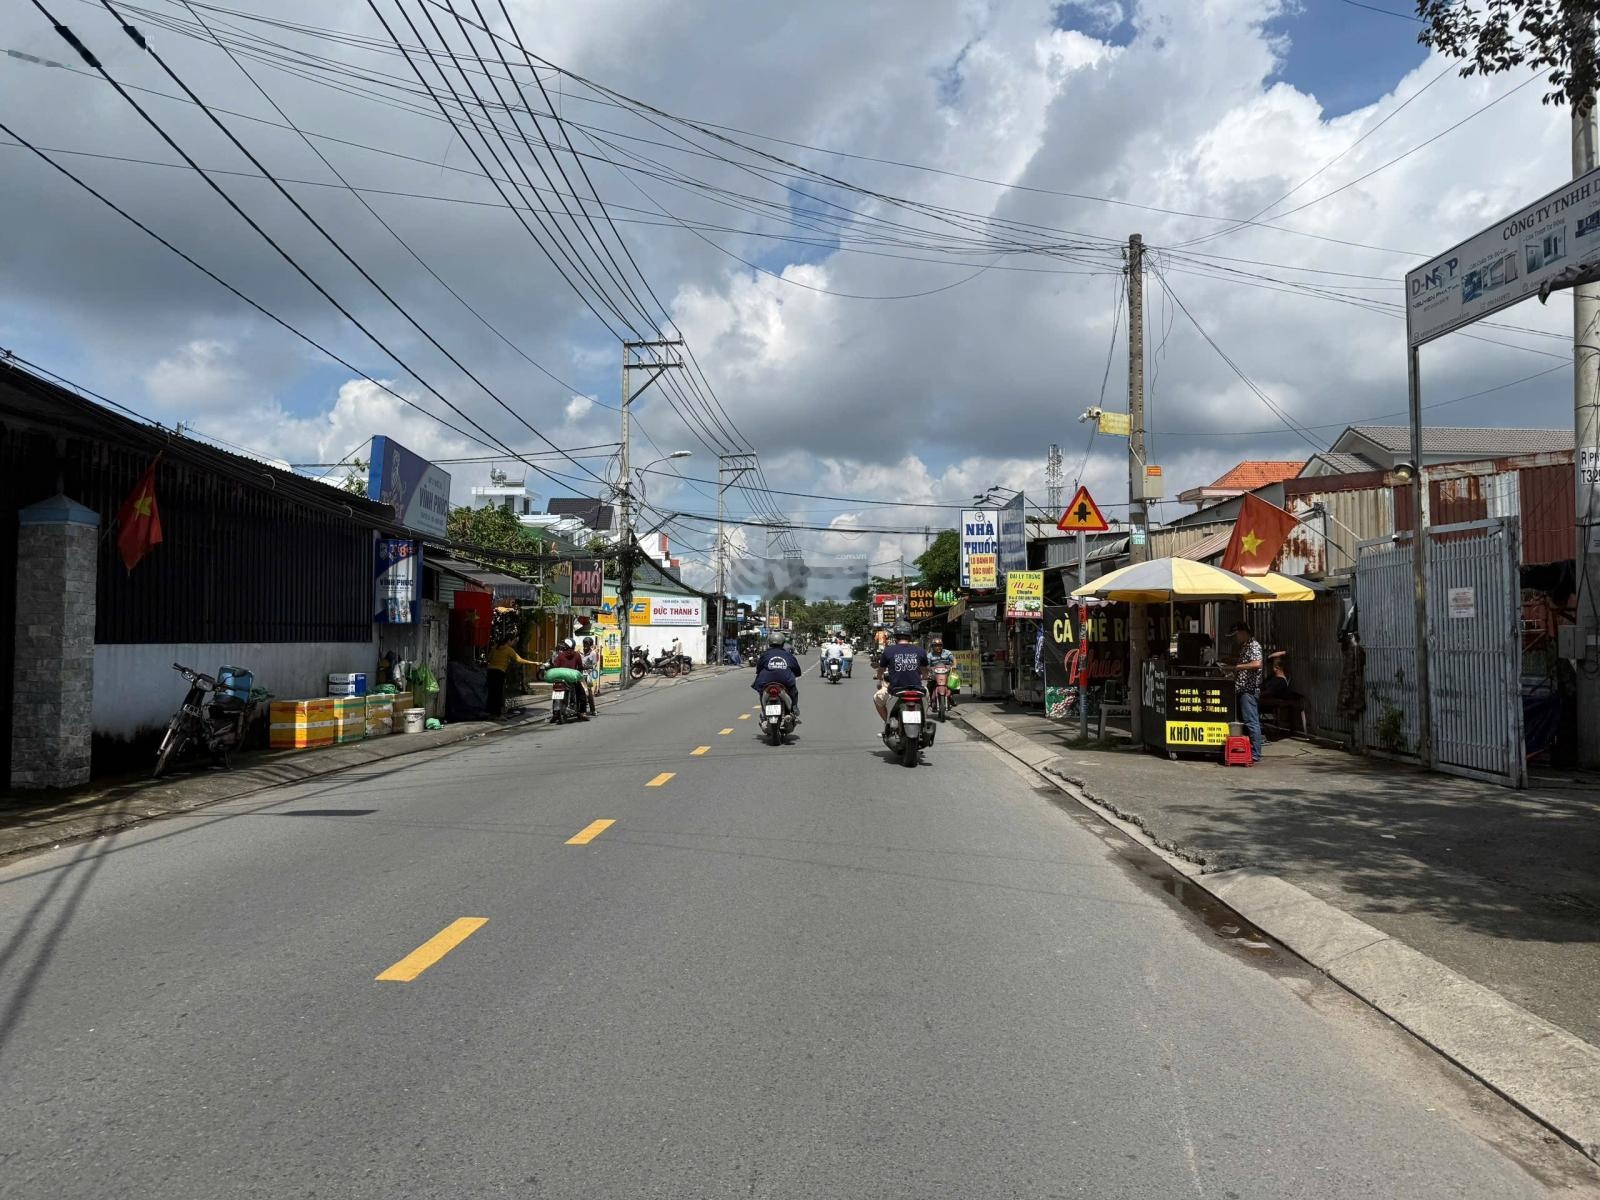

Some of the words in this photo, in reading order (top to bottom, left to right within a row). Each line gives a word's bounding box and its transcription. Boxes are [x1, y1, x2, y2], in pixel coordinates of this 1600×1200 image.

[1503, 213, 1534, 240] CÔNG
[1536, 204, 1551, 223] TY
[1553, 183, 1591, 214] TNHH
[1581, 470, 1600, 483] T32
[966, 521, 994, 535] NHÀ
[964, 537, 997, 554] THUỐC
[573, 562, 601, 593] PHỞ
[910, 588, 933, 598] BÚN
[653, 606, 668, 615] ĐỨC
[670, 606, 693, 616] THÀNH
[694, 608, 699, 616] 5
[910, 599, 933, 610] ĐẬU
[1053, 613, 1074, 643] CÀ
[1170, 724, 1204, 742] KHÔNG
